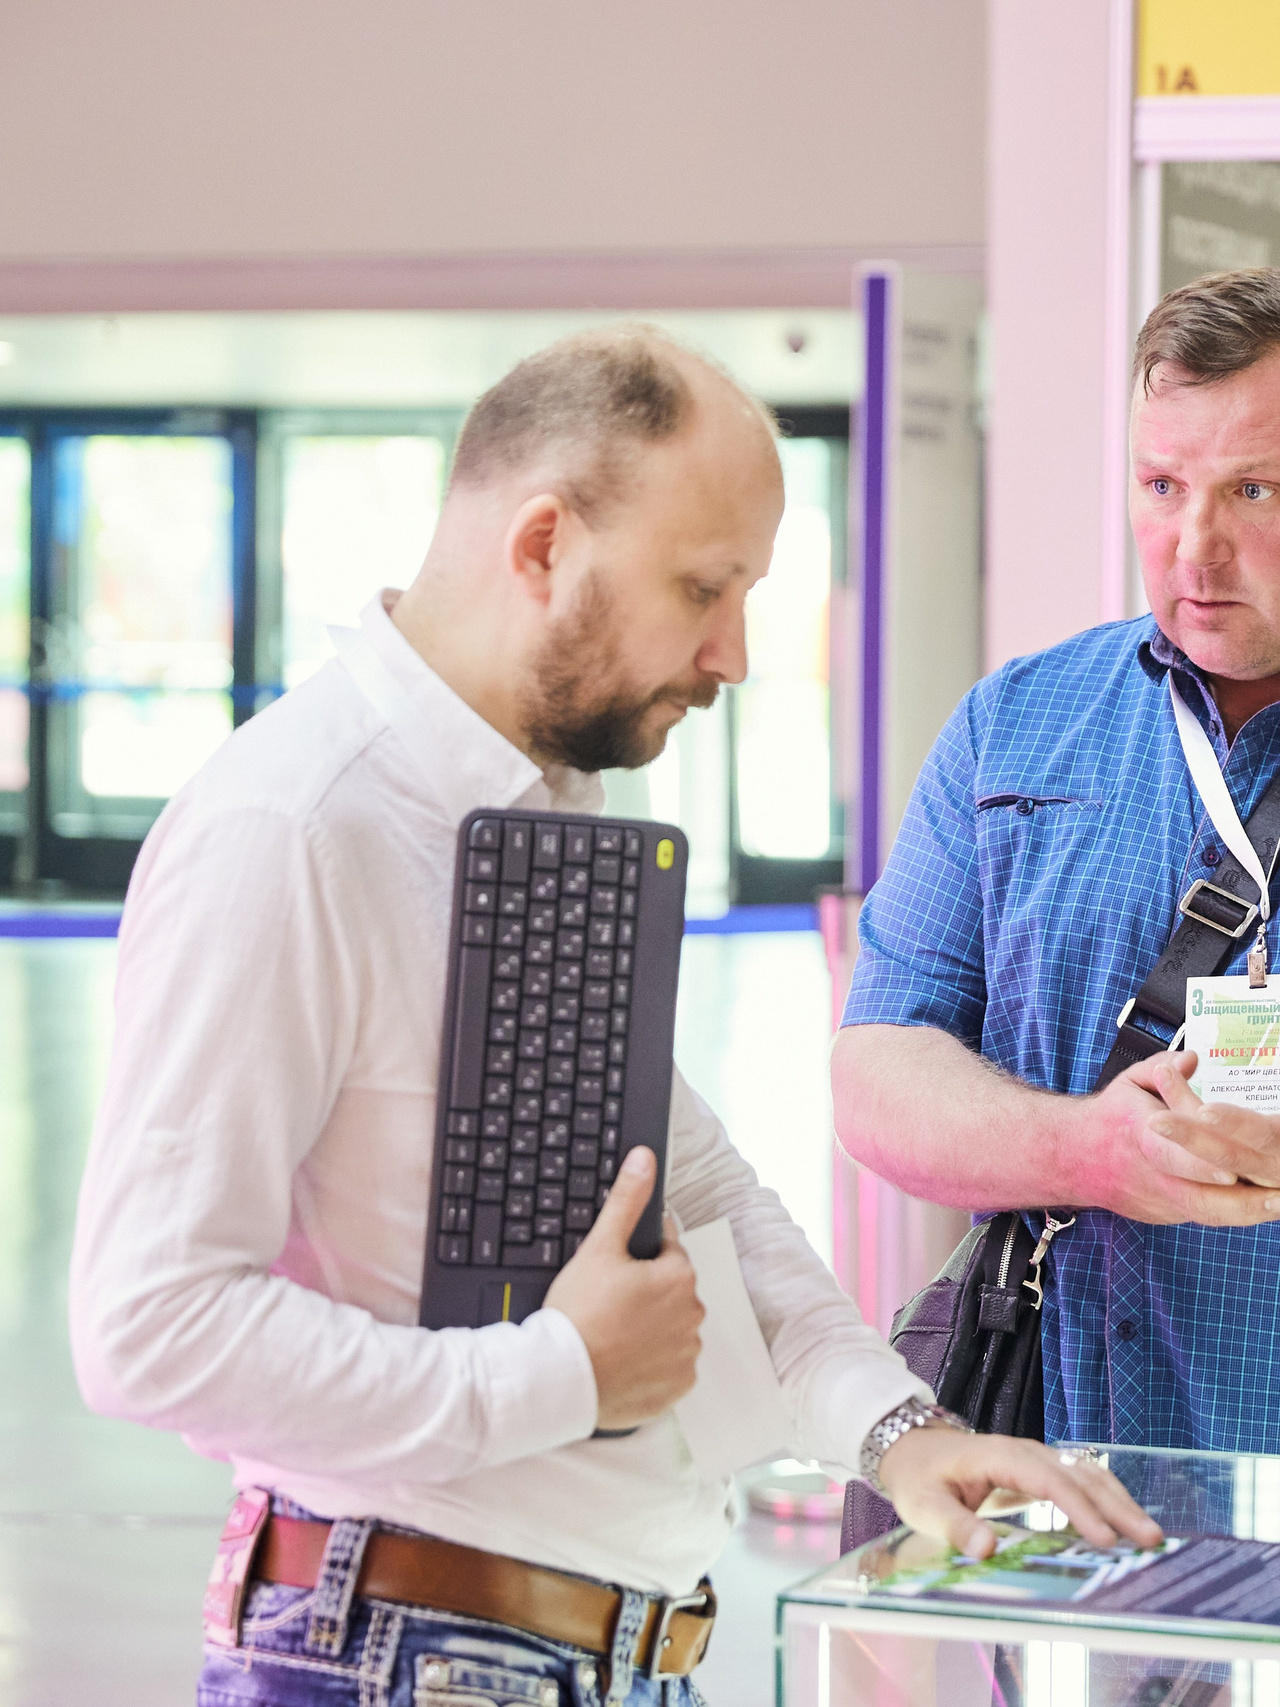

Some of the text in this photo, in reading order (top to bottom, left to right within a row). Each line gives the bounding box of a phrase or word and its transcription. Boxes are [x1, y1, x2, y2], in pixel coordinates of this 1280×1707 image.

[1191, 988, 1280, 1017] Защищенный
[1247, 1014, 1280, 1026] грунт
[1210, 1085, 1256, 1093] АЛЕКСАНДР
